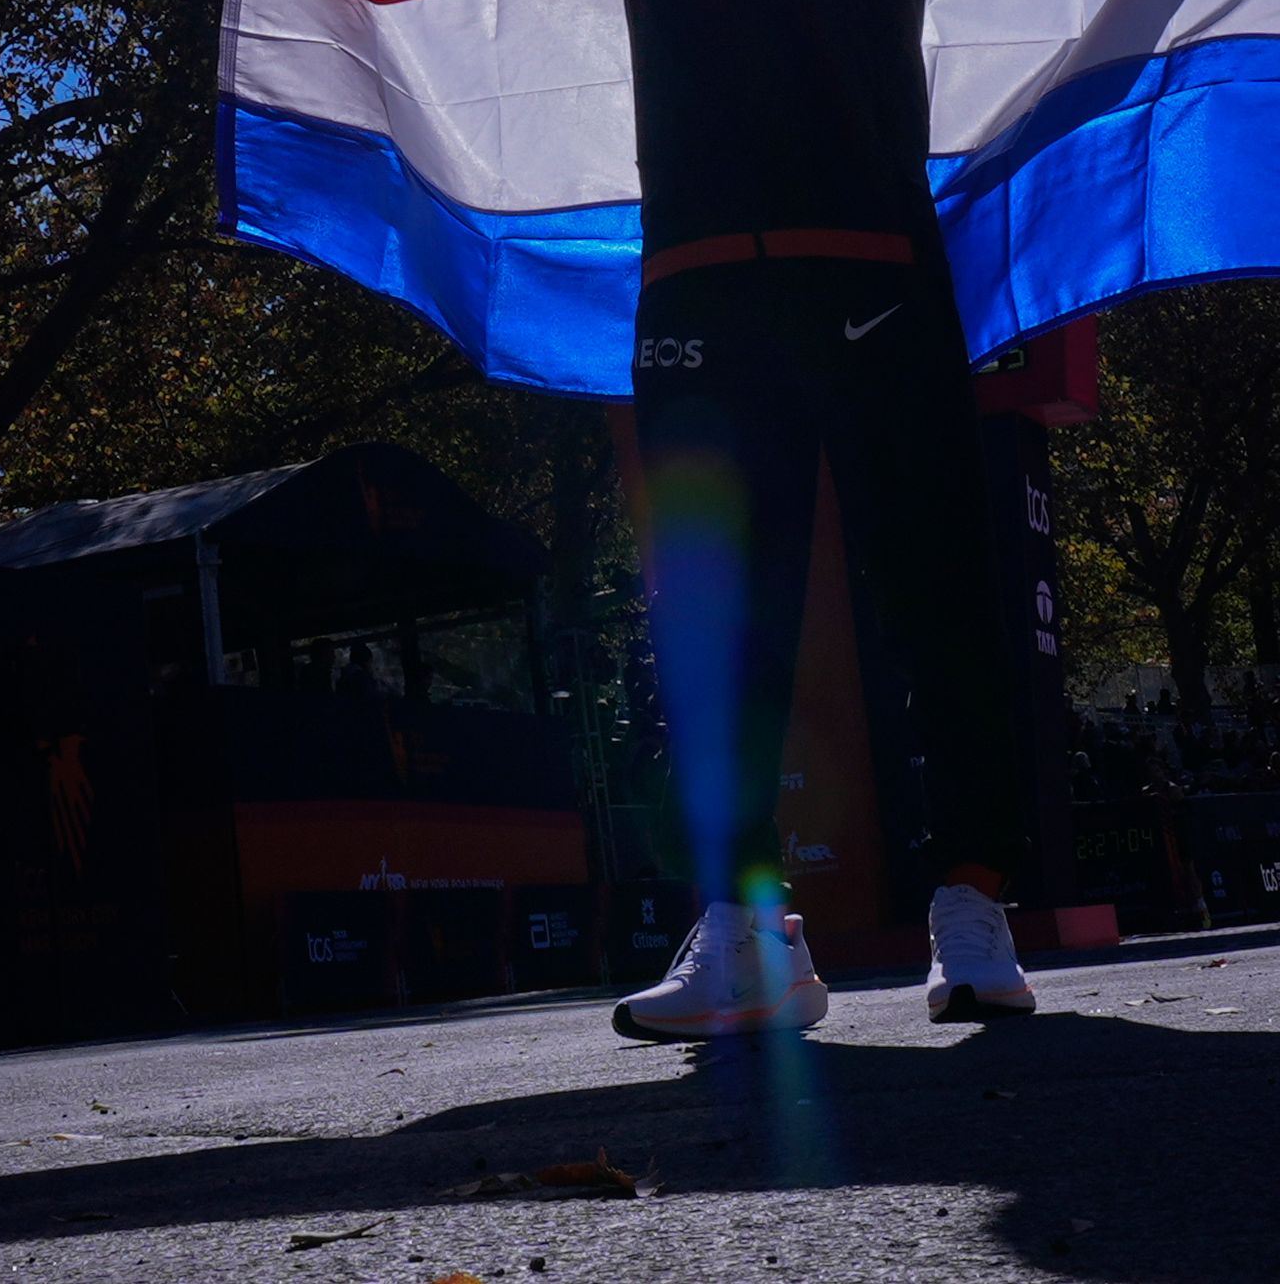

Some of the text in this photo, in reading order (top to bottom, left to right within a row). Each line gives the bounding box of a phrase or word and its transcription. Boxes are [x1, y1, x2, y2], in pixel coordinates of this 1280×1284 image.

[635, 337, 705, 369] EOS
[1025, 473, 1050, 536] tcs
[1259, 862, 1279, 893] tcs
[306, 931, 334, 963] tcs
